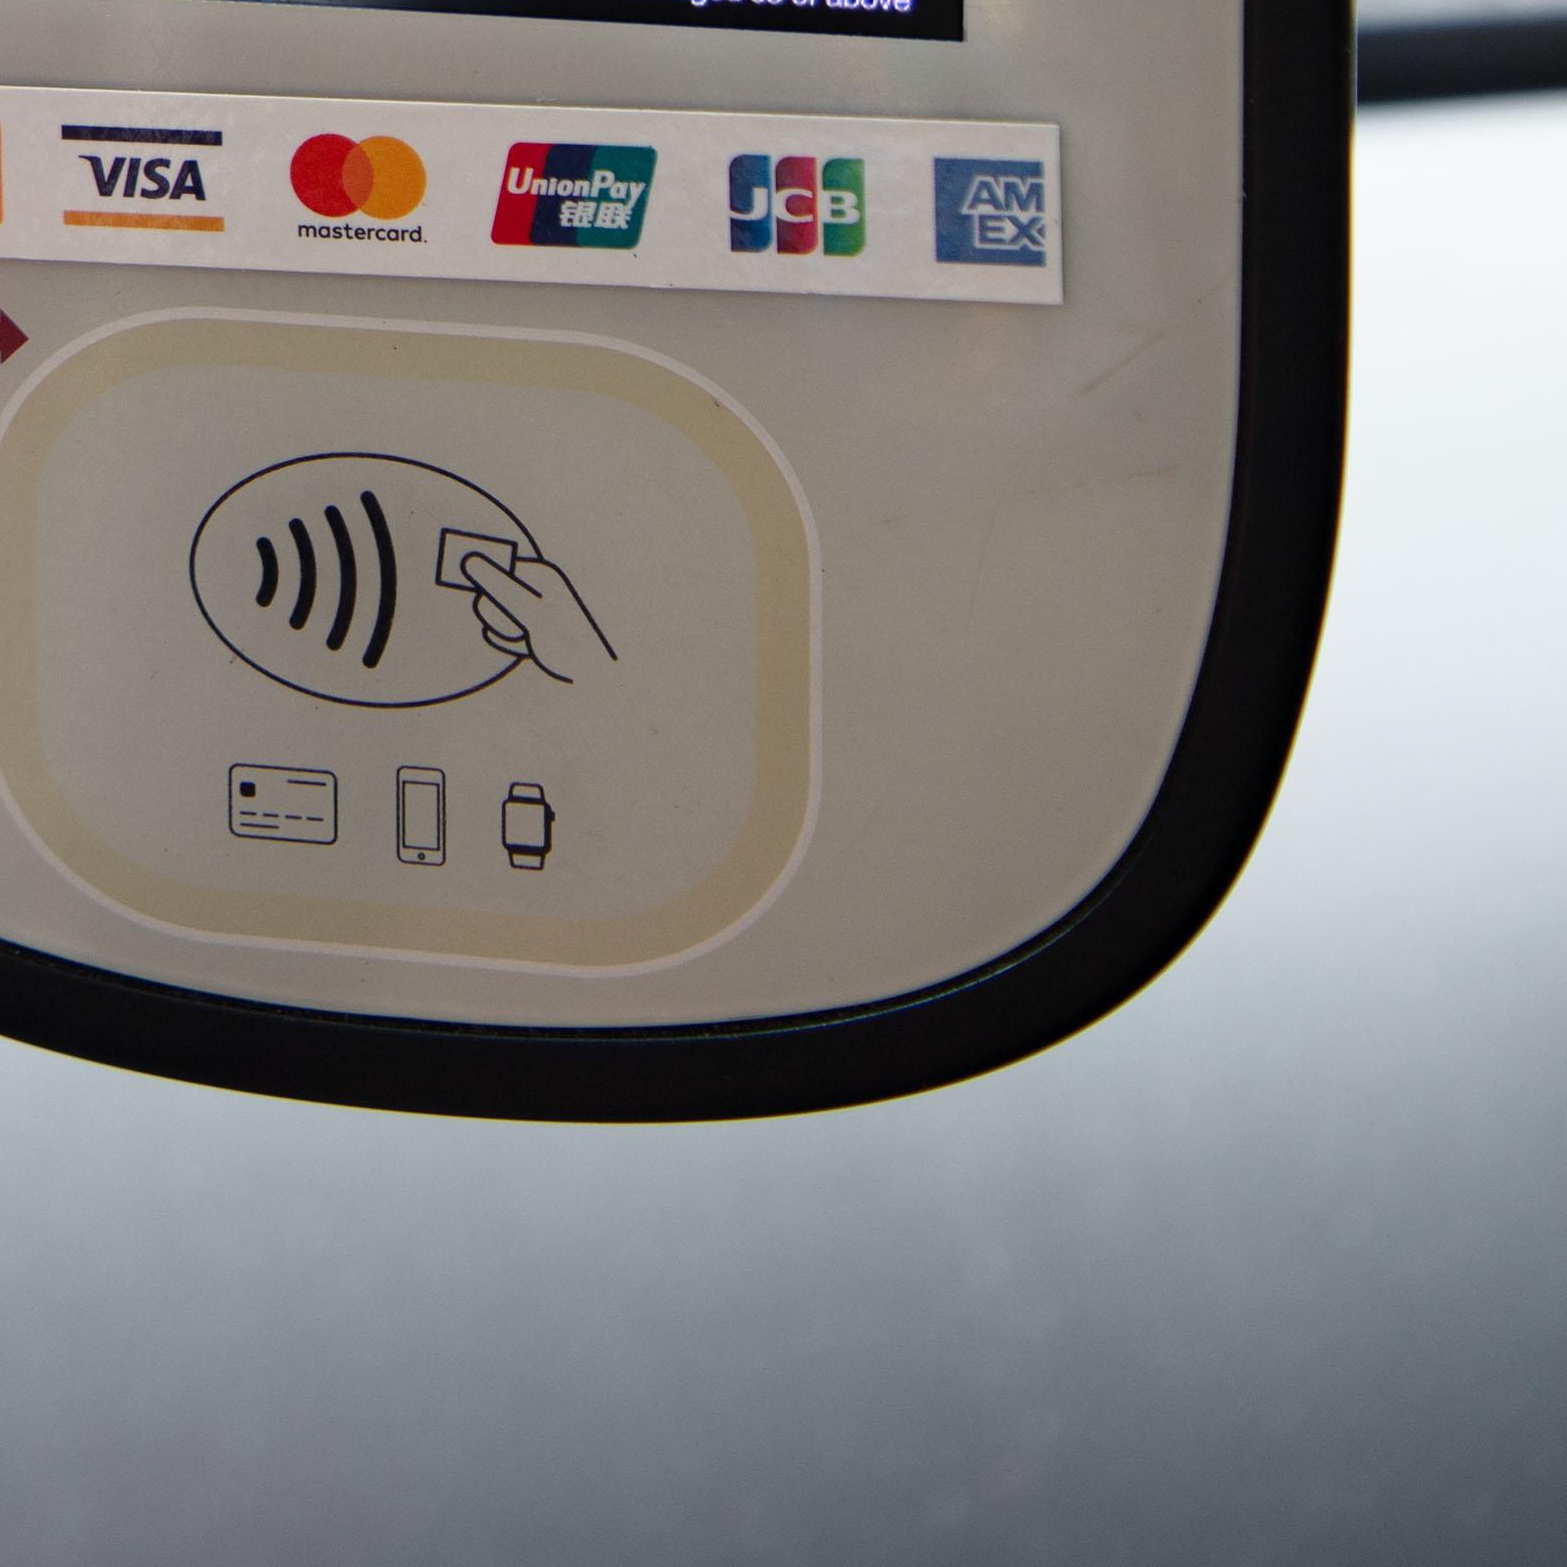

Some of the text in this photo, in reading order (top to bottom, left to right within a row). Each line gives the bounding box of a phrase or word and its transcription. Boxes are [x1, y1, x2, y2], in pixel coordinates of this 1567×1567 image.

[77, 154, 207, 202] VISA
[506, 166, 647, 207] UnionPay
[559, 200, 634, 230] 银联
[729, 186, 861, 226] JCB
